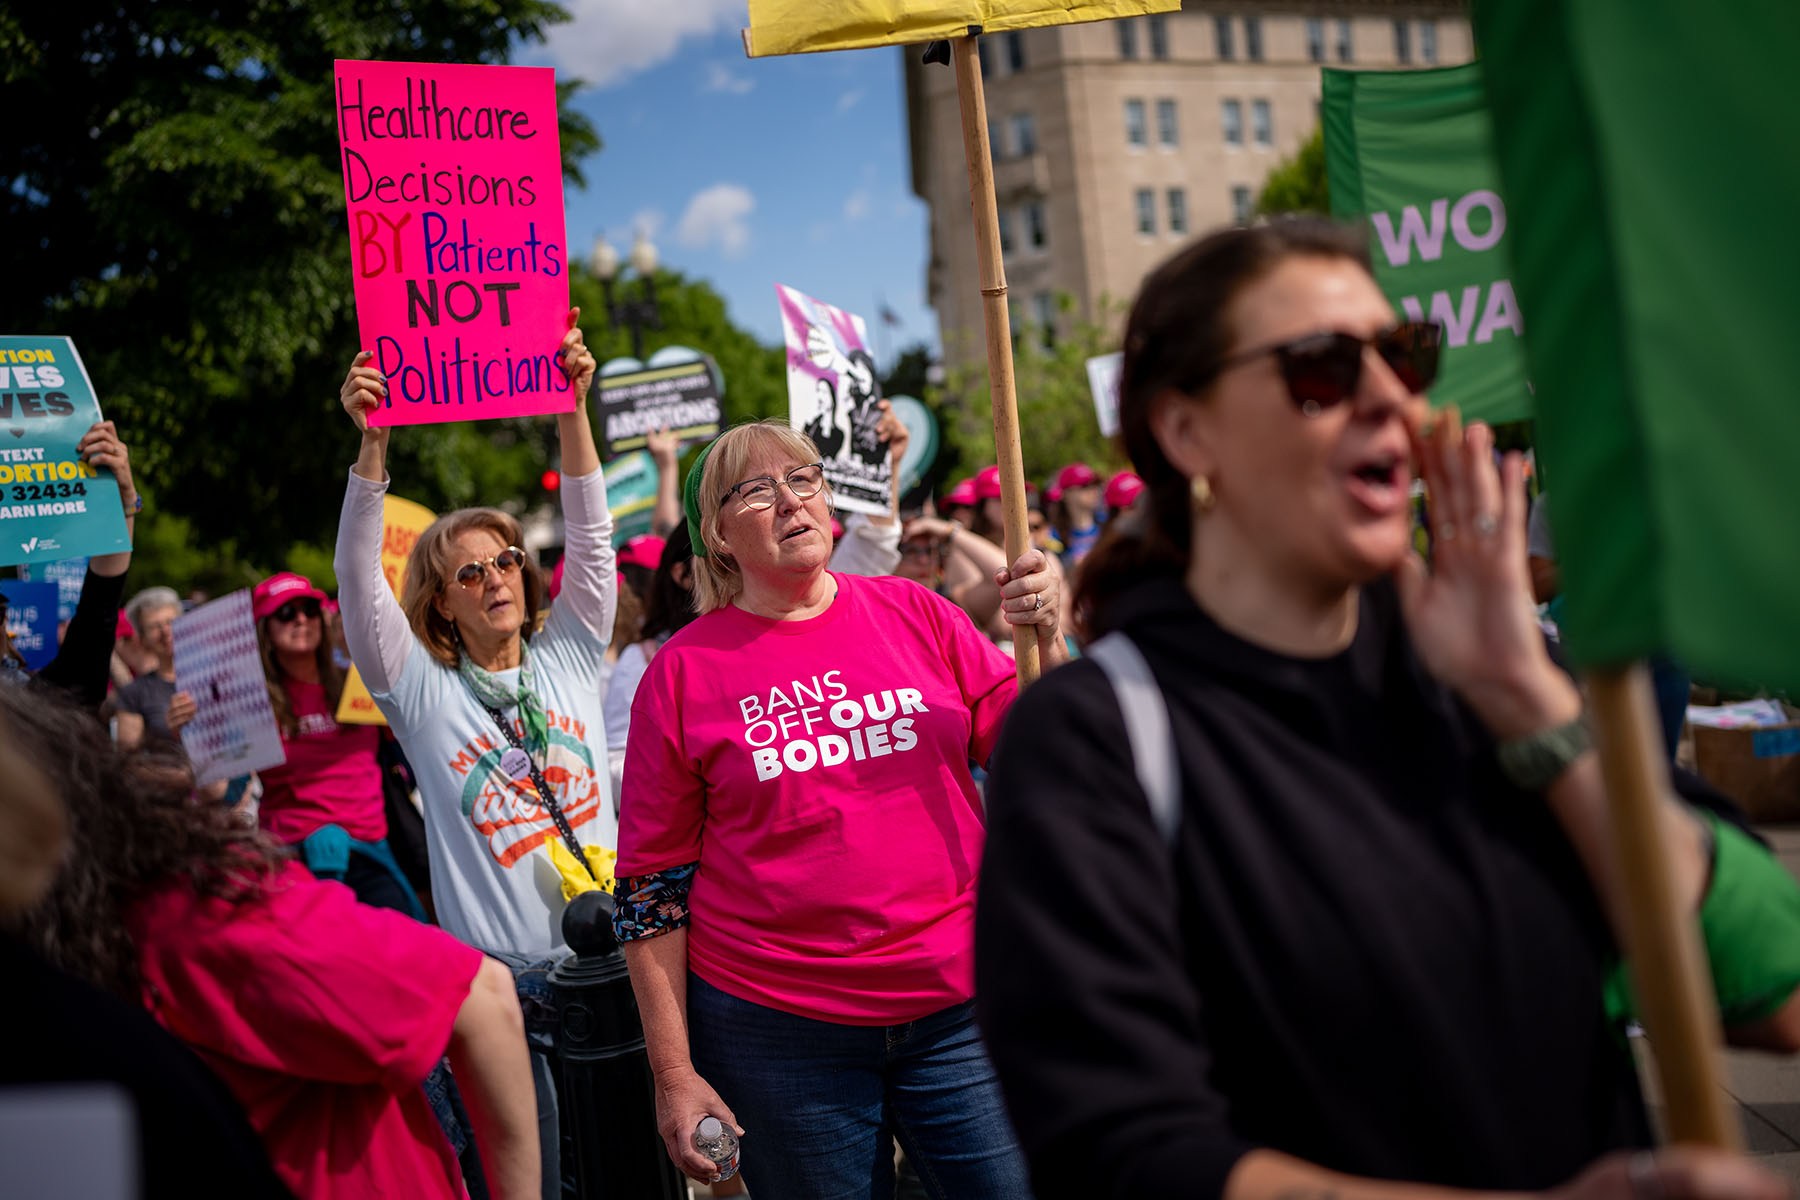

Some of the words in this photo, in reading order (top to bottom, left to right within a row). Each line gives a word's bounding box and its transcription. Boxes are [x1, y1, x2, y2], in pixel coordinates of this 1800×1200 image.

[338, 77, 537, 141] Healthcare
[344, 147, 537, 207] Decisions
[356, 210, 411, 278] BY
[422, 211, 561, 276] Patients
[1371, 189, 1507, 267] WO
[405, 279, 520, 328] NOT
[0, 349, 55, 363] TION
[376, 336, 571, 408] Politicians
[0, 447, 44, 462] TEXT
[0, 504, 36, 519] ARN
[37, 500, 87, 516] MORE
[12, 482, 87, 501] 32434
[739, 670, 847, 724] BANS
[744, 705, 823, 747] OFF
[829, 688, 930, 729] OUR
[449, 732, 498, 776] MIN
[752, 718, 918, 782] BODIES
